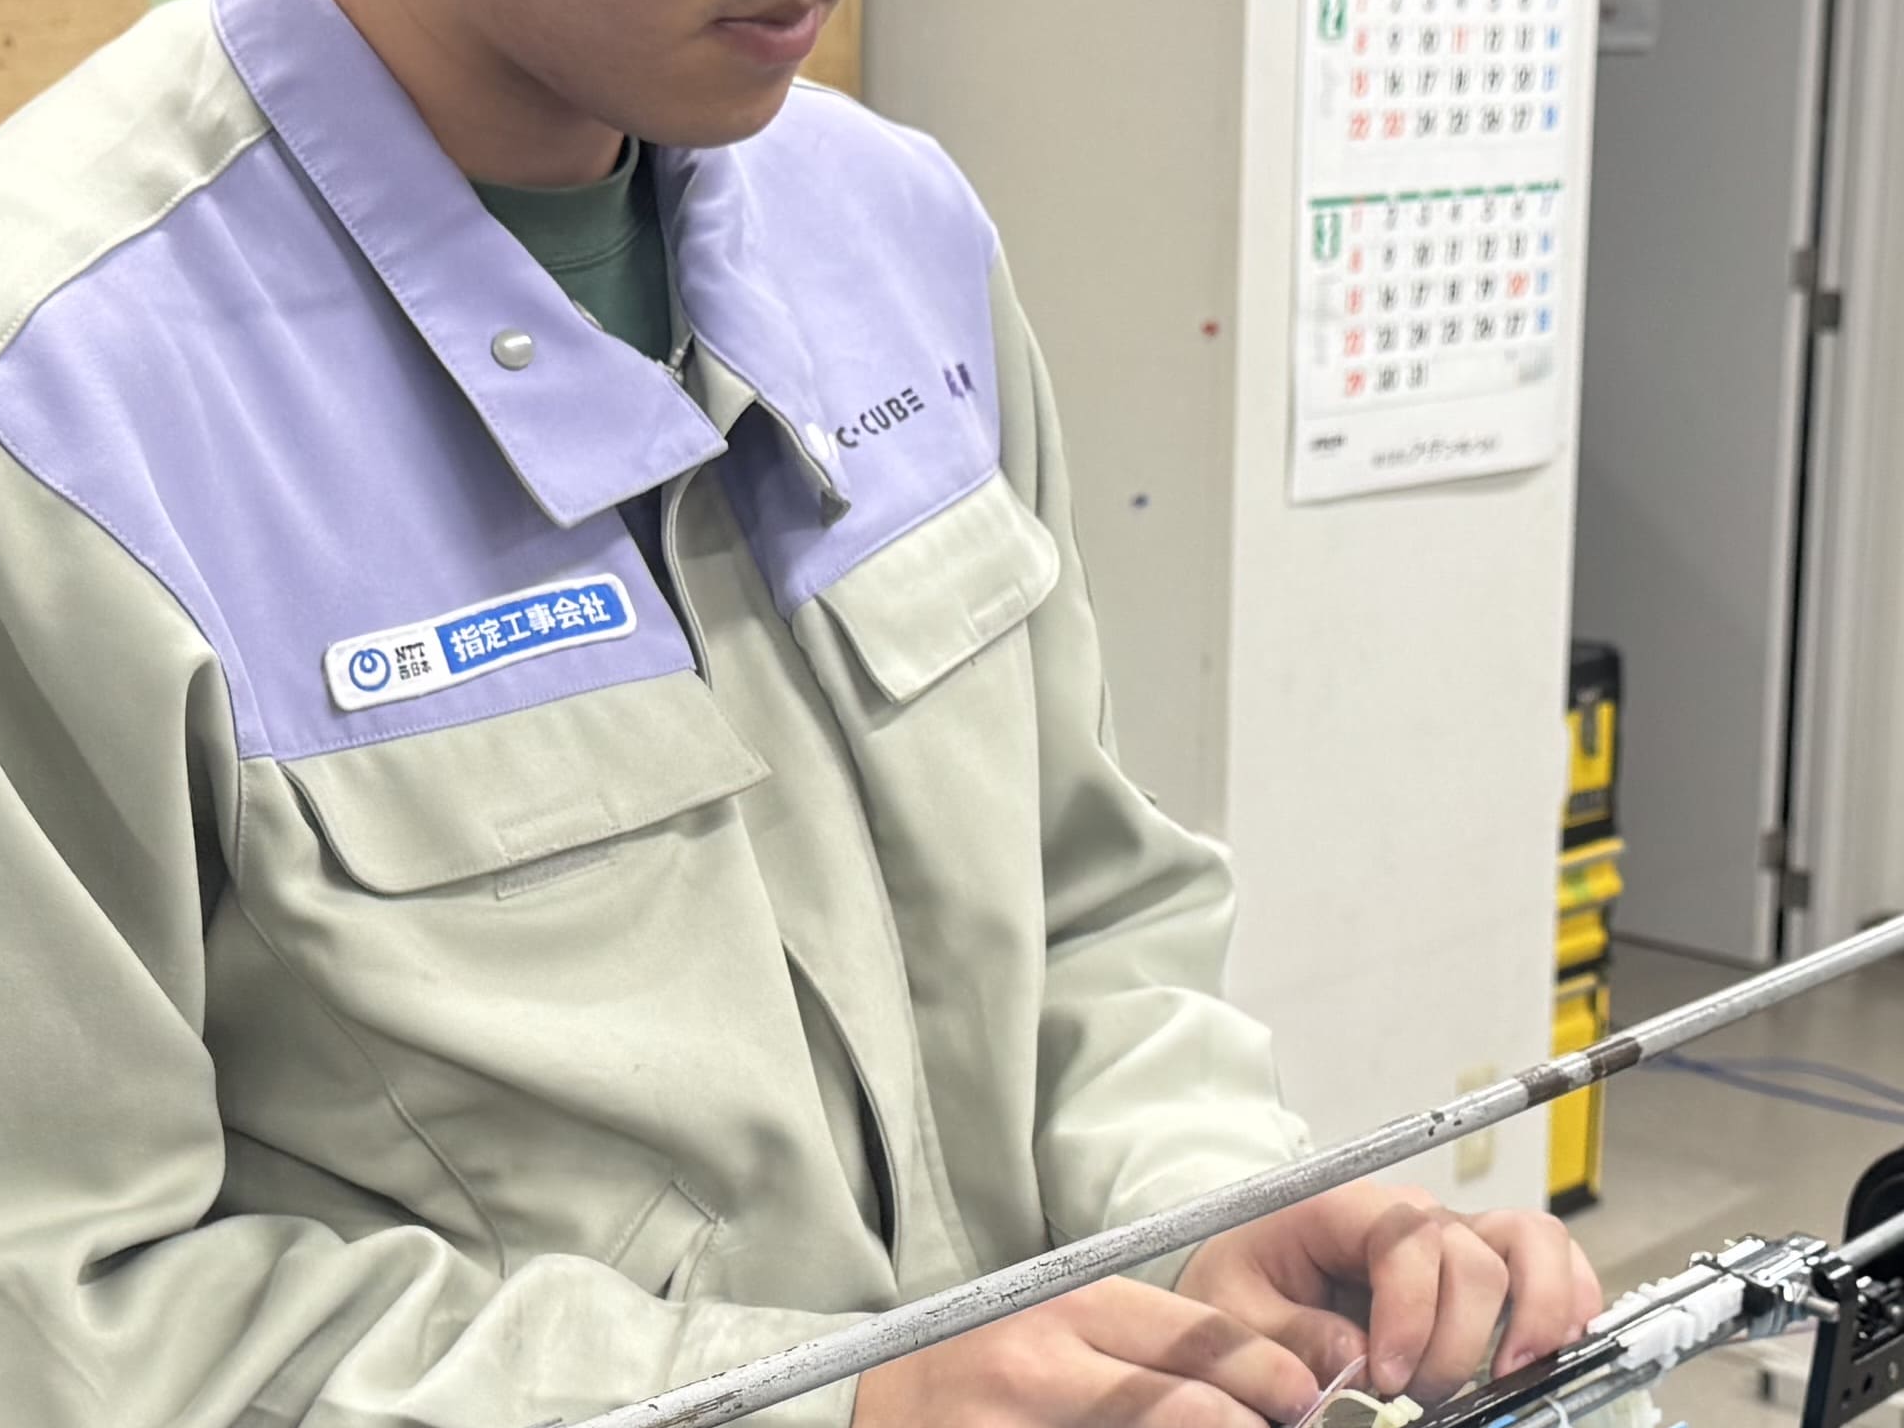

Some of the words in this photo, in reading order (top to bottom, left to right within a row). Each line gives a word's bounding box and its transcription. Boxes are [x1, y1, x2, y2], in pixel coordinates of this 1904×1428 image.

[450, 590, 612, 664] 指定工事会社
[396, 642, 426, 664] NTT
